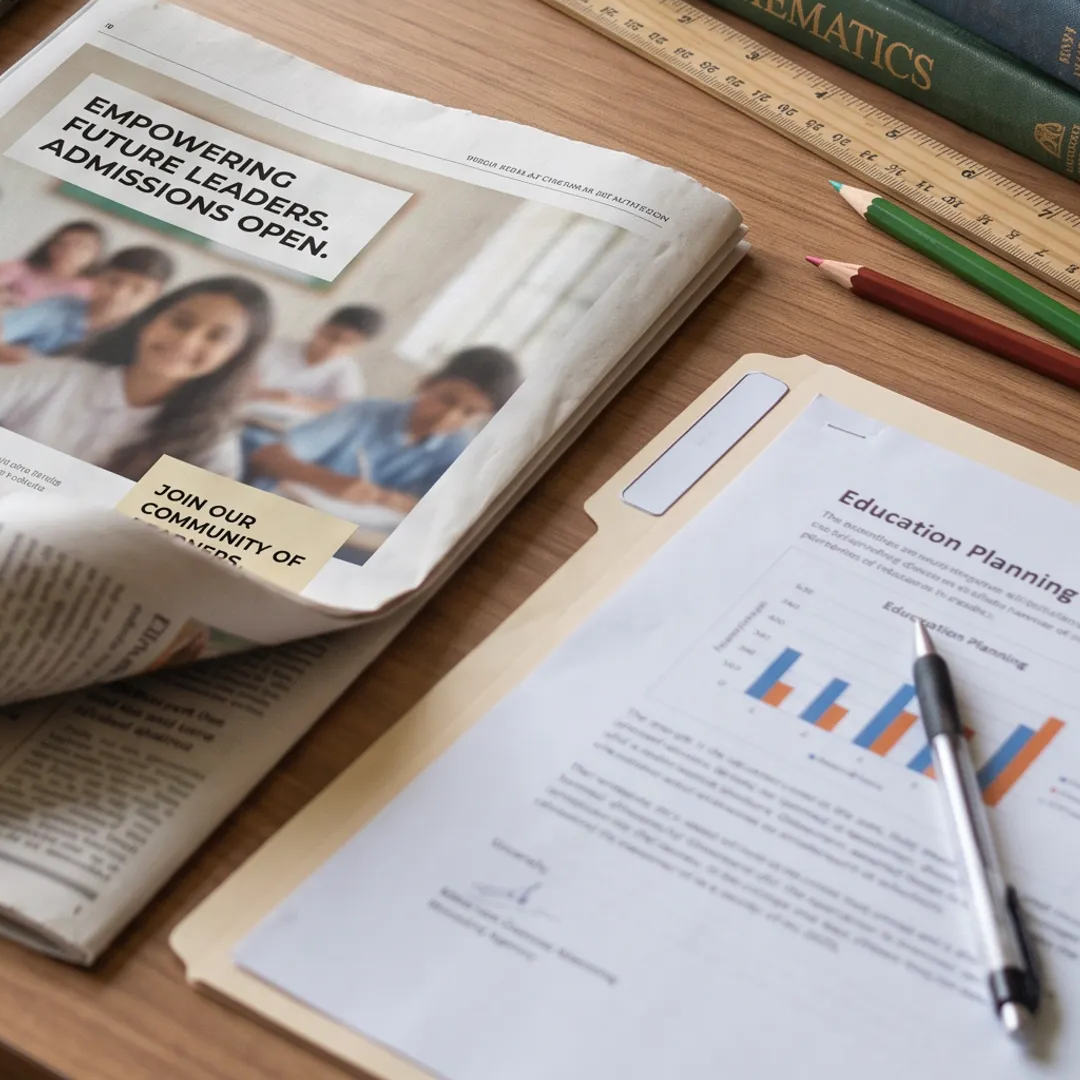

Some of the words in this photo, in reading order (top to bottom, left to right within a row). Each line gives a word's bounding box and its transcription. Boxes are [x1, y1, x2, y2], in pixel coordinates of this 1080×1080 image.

[62, 116, 185, 175] FUTURE
[184, 166, 331, 231] LEADERS.
[84, 96, 297, 188] EMPOWERING
[38, 139, 234, 222] ADMISSIONS
[237, 215, 328, 259] OPEN.
[141, 502, 273, 556] COMMUNITY
[272, 550, 306, 568] OF
[154, 484, 208, 511] JOIN
[209, 505, 257, 530] OUR
[838, 489, 962, 551] Education
[966, 544, 1080, 605] Planning
[967, 637, 1030, 671] Planning
